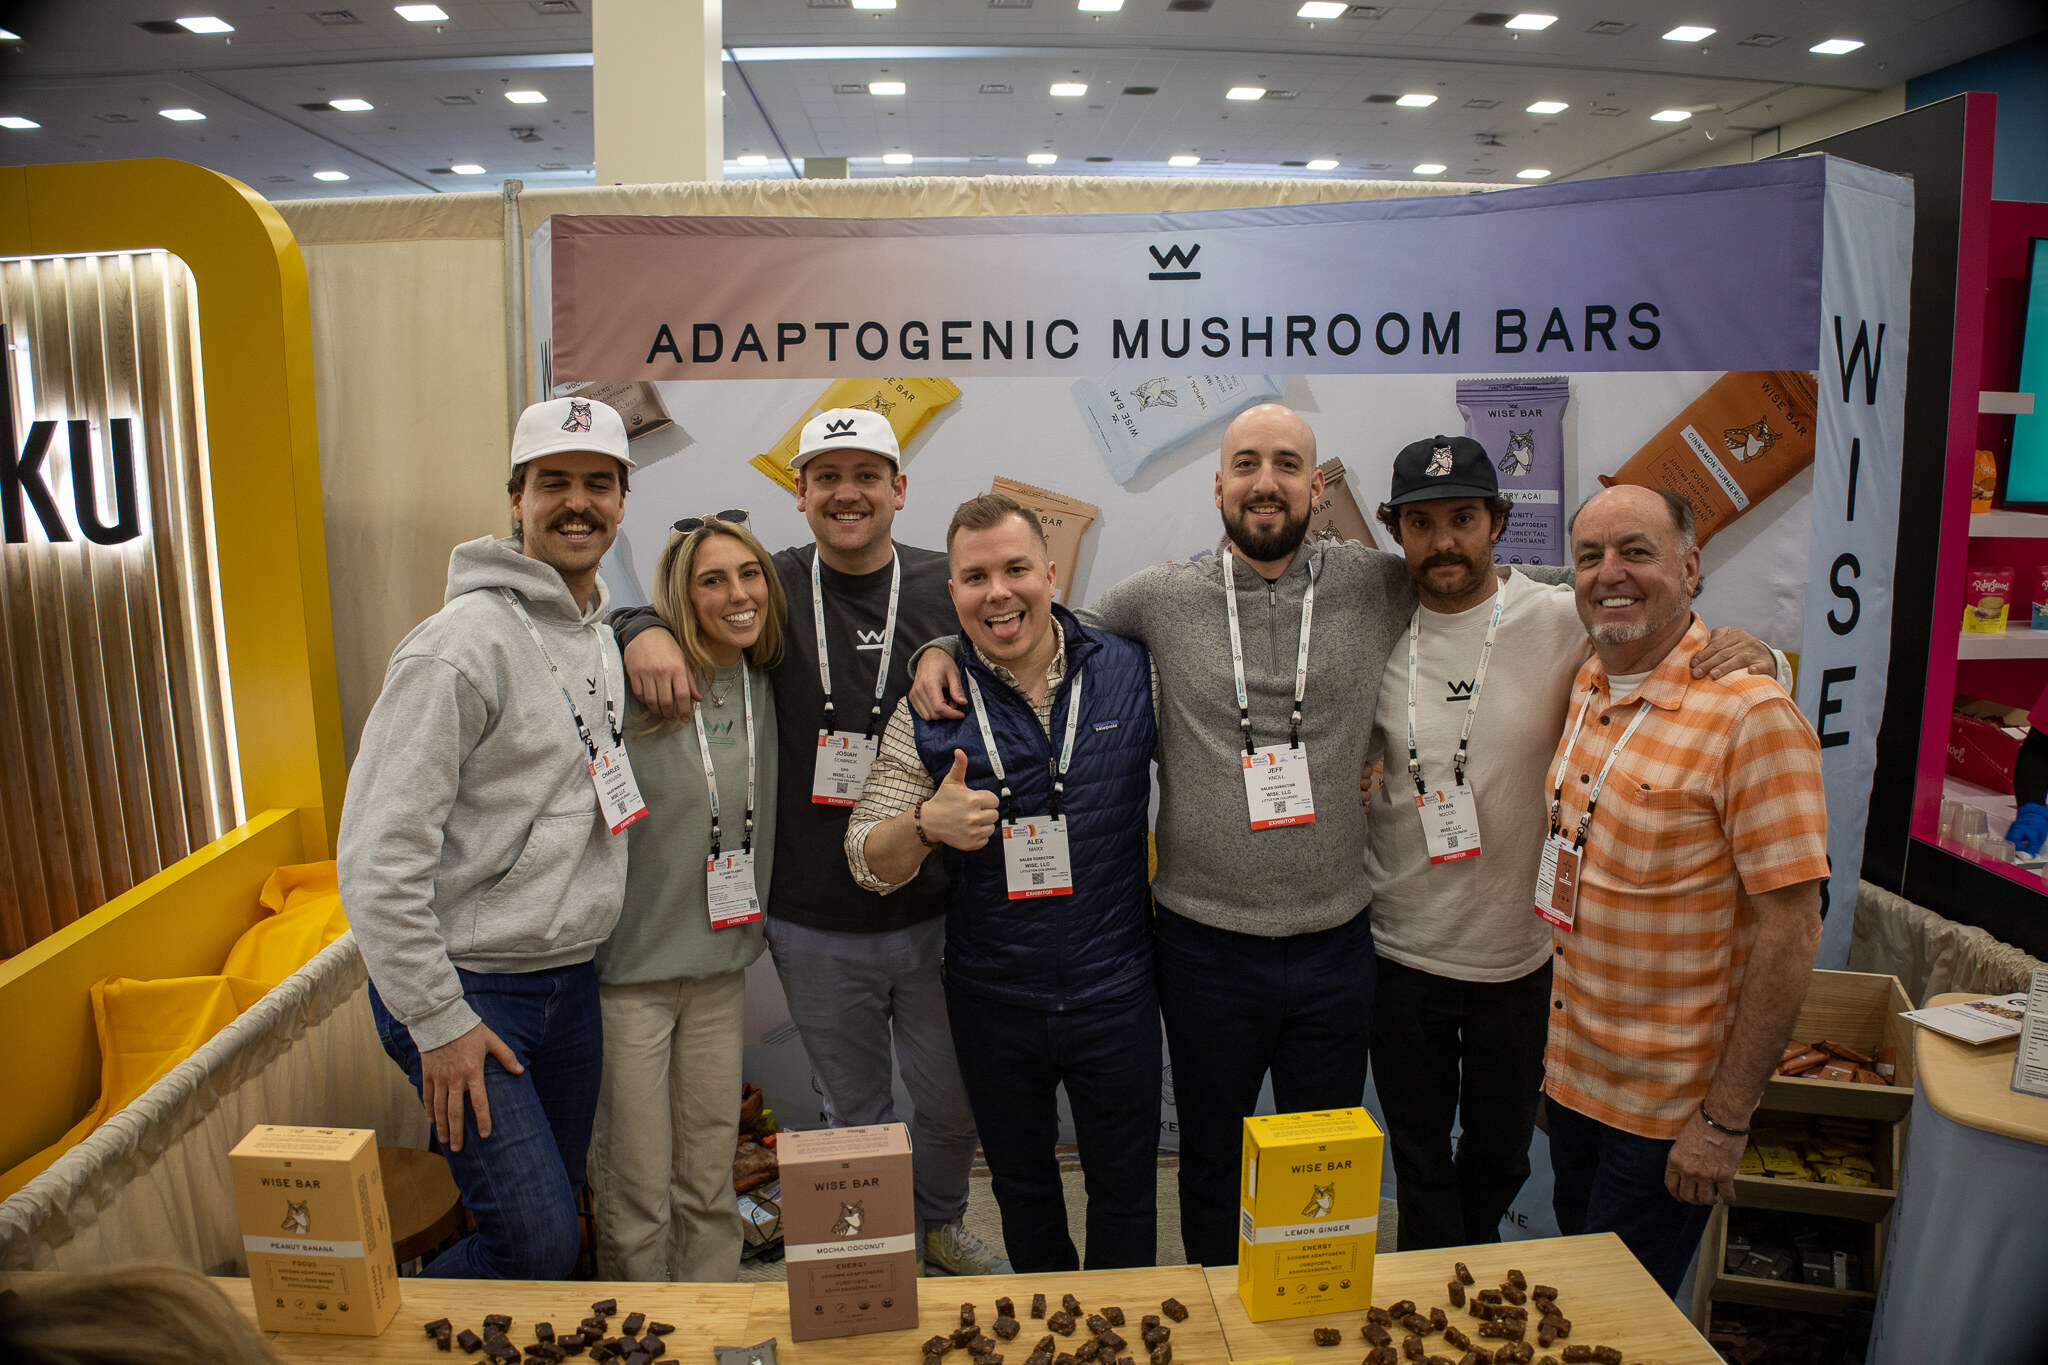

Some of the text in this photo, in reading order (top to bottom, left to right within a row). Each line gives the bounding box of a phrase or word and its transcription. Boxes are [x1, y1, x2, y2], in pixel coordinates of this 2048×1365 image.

[646, 302, 1661, 365] ADAPTOGENIC MUSHROOM BARS
[565, 381, 585, 391] MOC
[588, 383, 614, 400] ENERGY
[895, 384, 916, 403] BAR
[1109, 389, 1139, 438] WISE BAR
[1488, 408, 1543, 418] WISE BAR
[1761, 380, 1787, 411] WISE
[1785, 412, 1808, 437] BAR
[1687, 432, 1744, 504] CINNAMON TURMERIC
[1689, 468, 1710, 493] FOCUS
[1687, 481, 1716, 518] ADAPTOGENS
[1311, 500, 1333, 515] BAR
[1041, 515, 1063, 528] BAR
[1817, 315, 1887, 750] WISE
[835, 750, 858, 758] JOSIAH
[1268, 766, 1283, 774] JEFF
[828, 797, 854, 805] EXHIBITOR
[1437, 802, 1454, 811] RYAN
[1268, 817, 1296, 826] EXHIBITOR
[1443, 851, 1467, 861] EXHIBITOR
[1025, 889, 1053, 897] EXHIBITOR
[1291, 1160, 1353, 1174] WISE BAR
[261, 1177, 321, 1189] WISE BAR
[814, 1177, 880, 1192] WISE BAR
[1285, 1224, 1350, 1237] LEMON GINGER
[270, 1242, 334, 1253] PEANUT BANANA
[816, 1242, 885, 1254] MOCHA COCONUT
[1302, 1243, 1332, 1252] ENERGY
[1310, 1250, 1346, 1258] ADAPTOGENS
[836, 1261, 868, 1270] ENERGY
